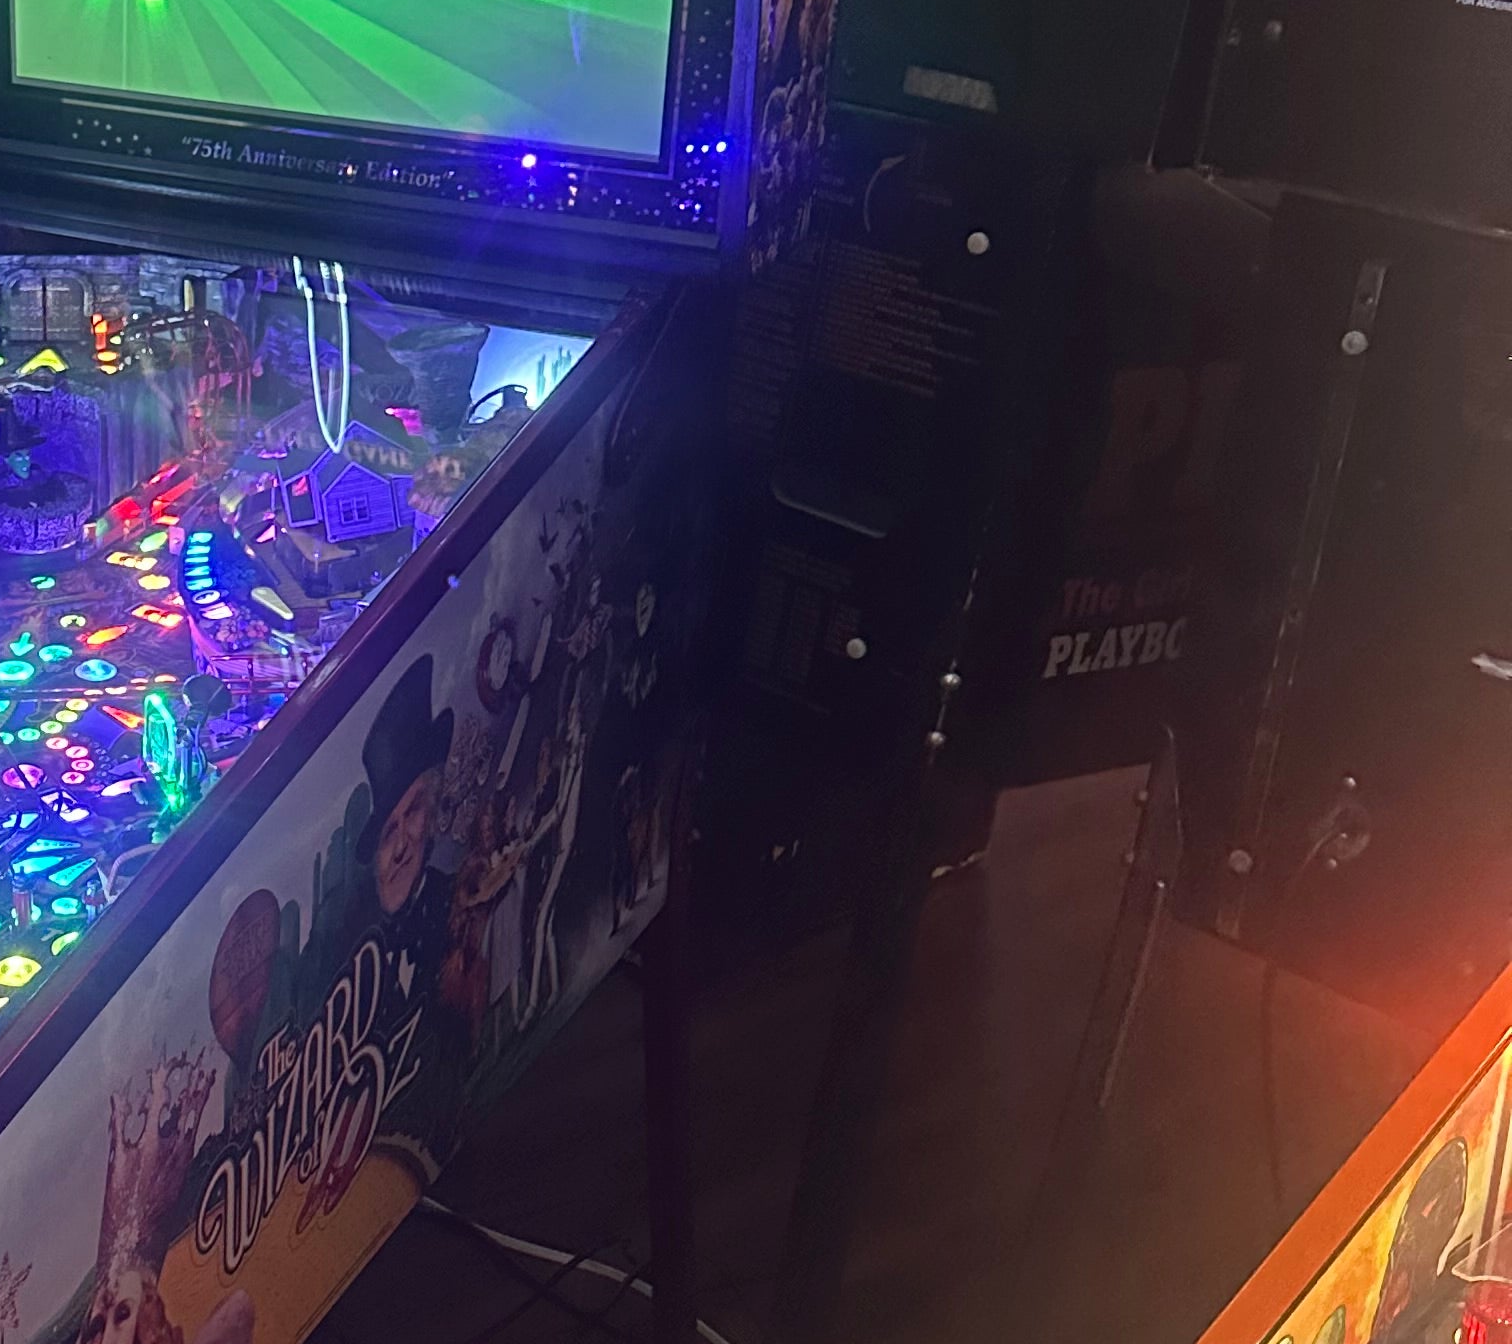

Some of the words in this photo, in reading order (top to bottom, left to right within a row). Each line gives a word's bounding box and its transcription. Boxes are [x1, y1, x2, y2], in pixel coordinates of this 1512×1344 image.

[238, 144, 359, 183] Anniversary
[1042, 618, 1187, 679] PLAYBO
[260, 1023, 297, 1090] The
[197, 940, 380, 1274] WIZARD
